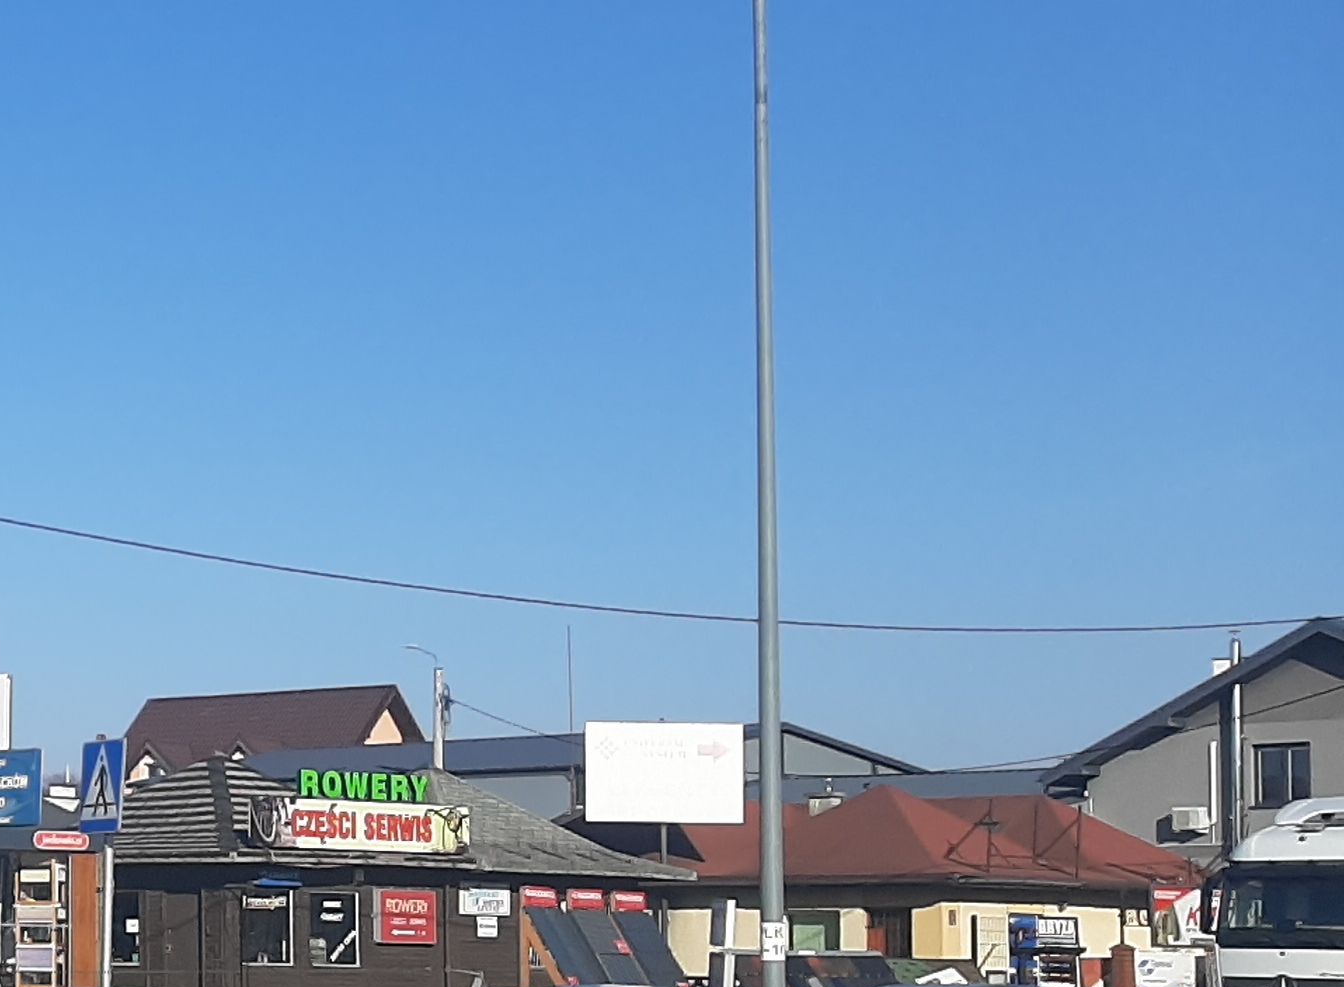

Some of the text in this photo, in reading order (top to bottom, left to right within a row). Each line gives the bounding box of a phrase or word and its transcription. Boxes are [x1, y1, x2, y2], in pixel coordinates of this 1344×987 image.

[299, 769, 429, 801] ROWERY
[291, 803, 433, 844] CZĘŚCI SERWIS
